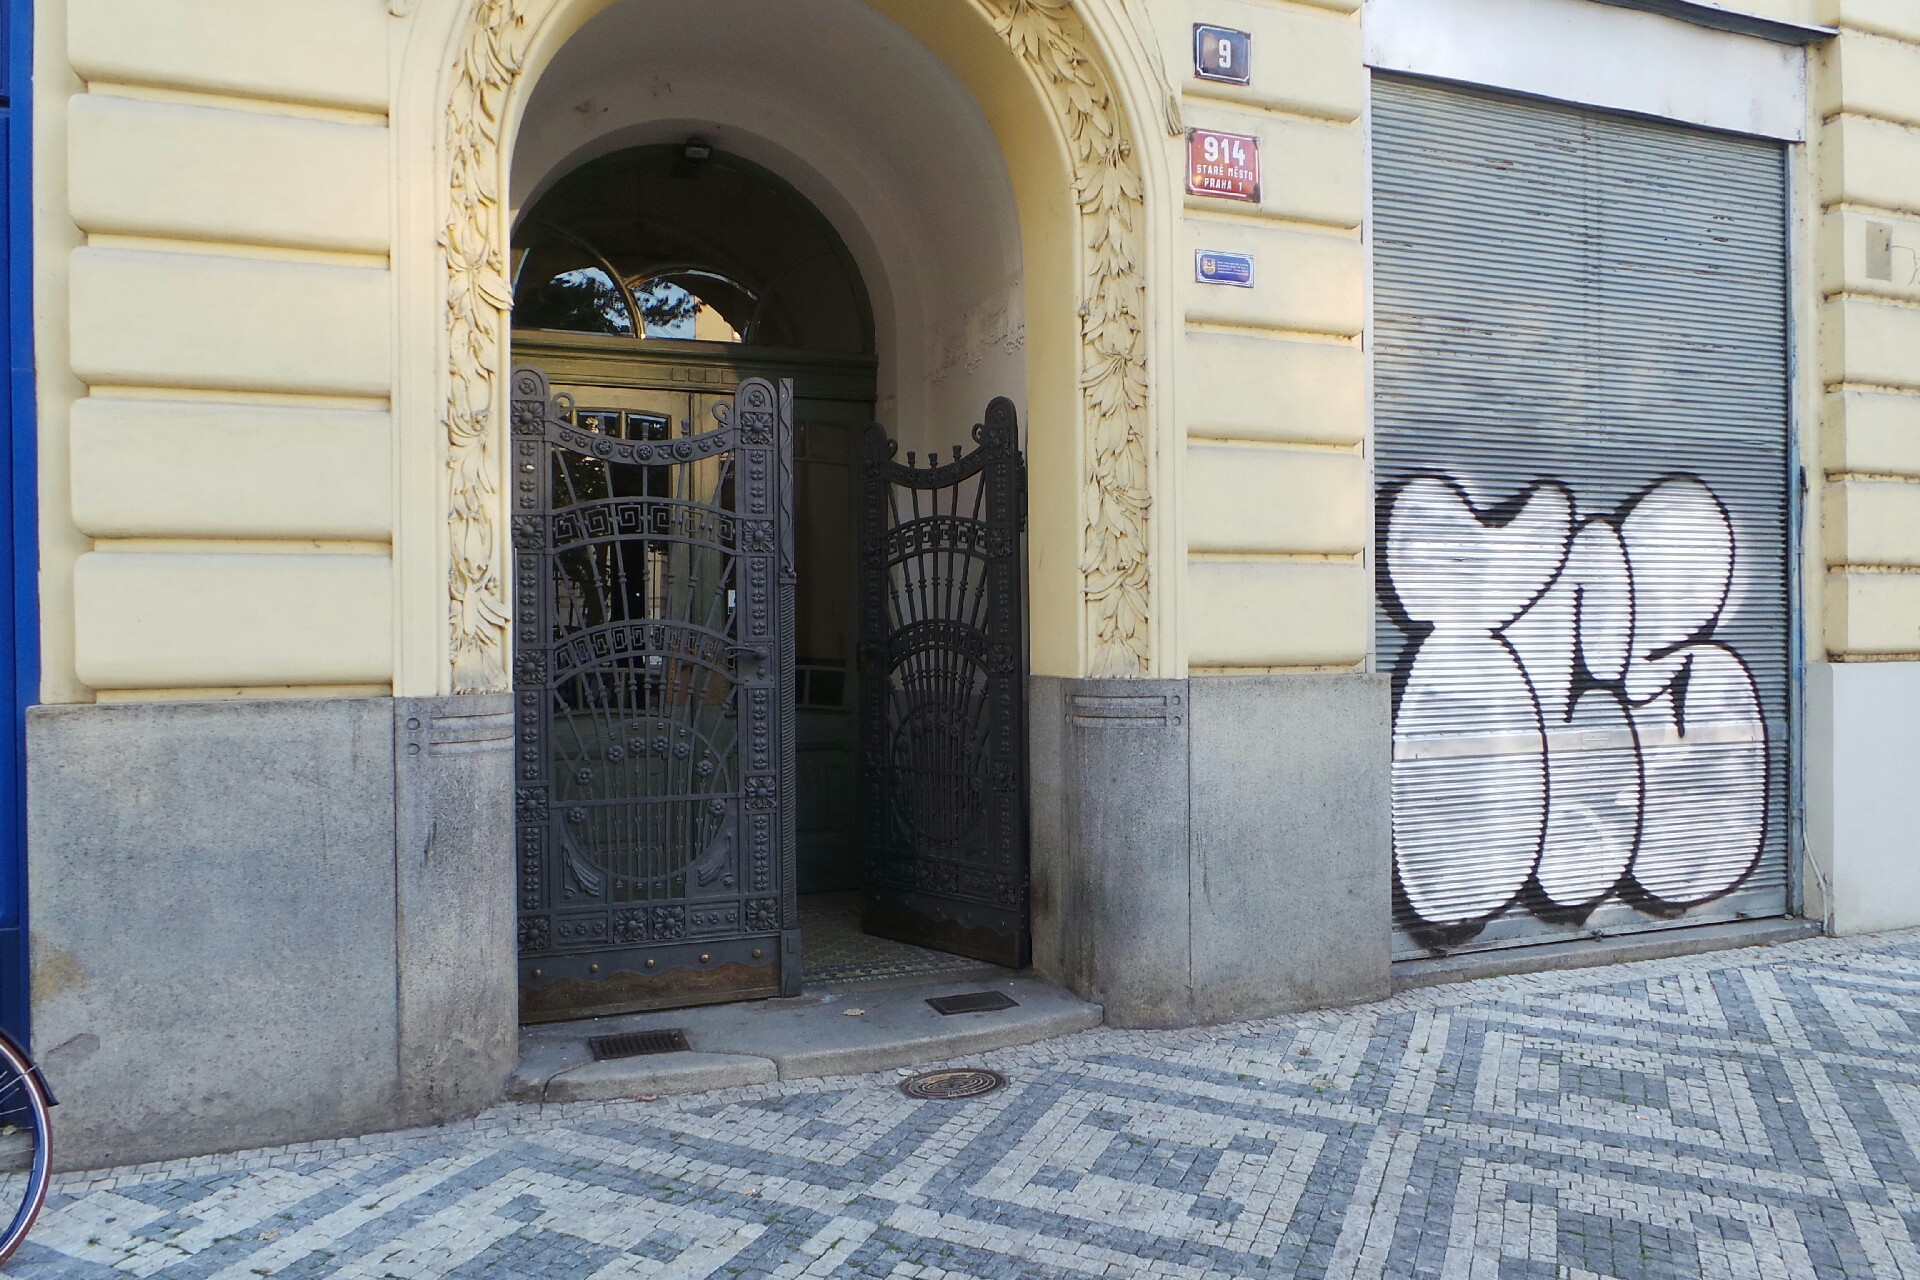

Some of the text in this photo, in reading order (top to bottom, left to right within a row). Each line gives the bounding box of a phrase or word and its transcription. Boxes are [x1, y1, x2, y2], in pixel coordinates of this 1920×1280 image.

[1219, 39, 1231, 68] 9
[1204, 136, 1245, 165] 914
[1196, 164, 1224, 175] STARÉ
[1204, 177, 1242, 192] PRAHA 1
